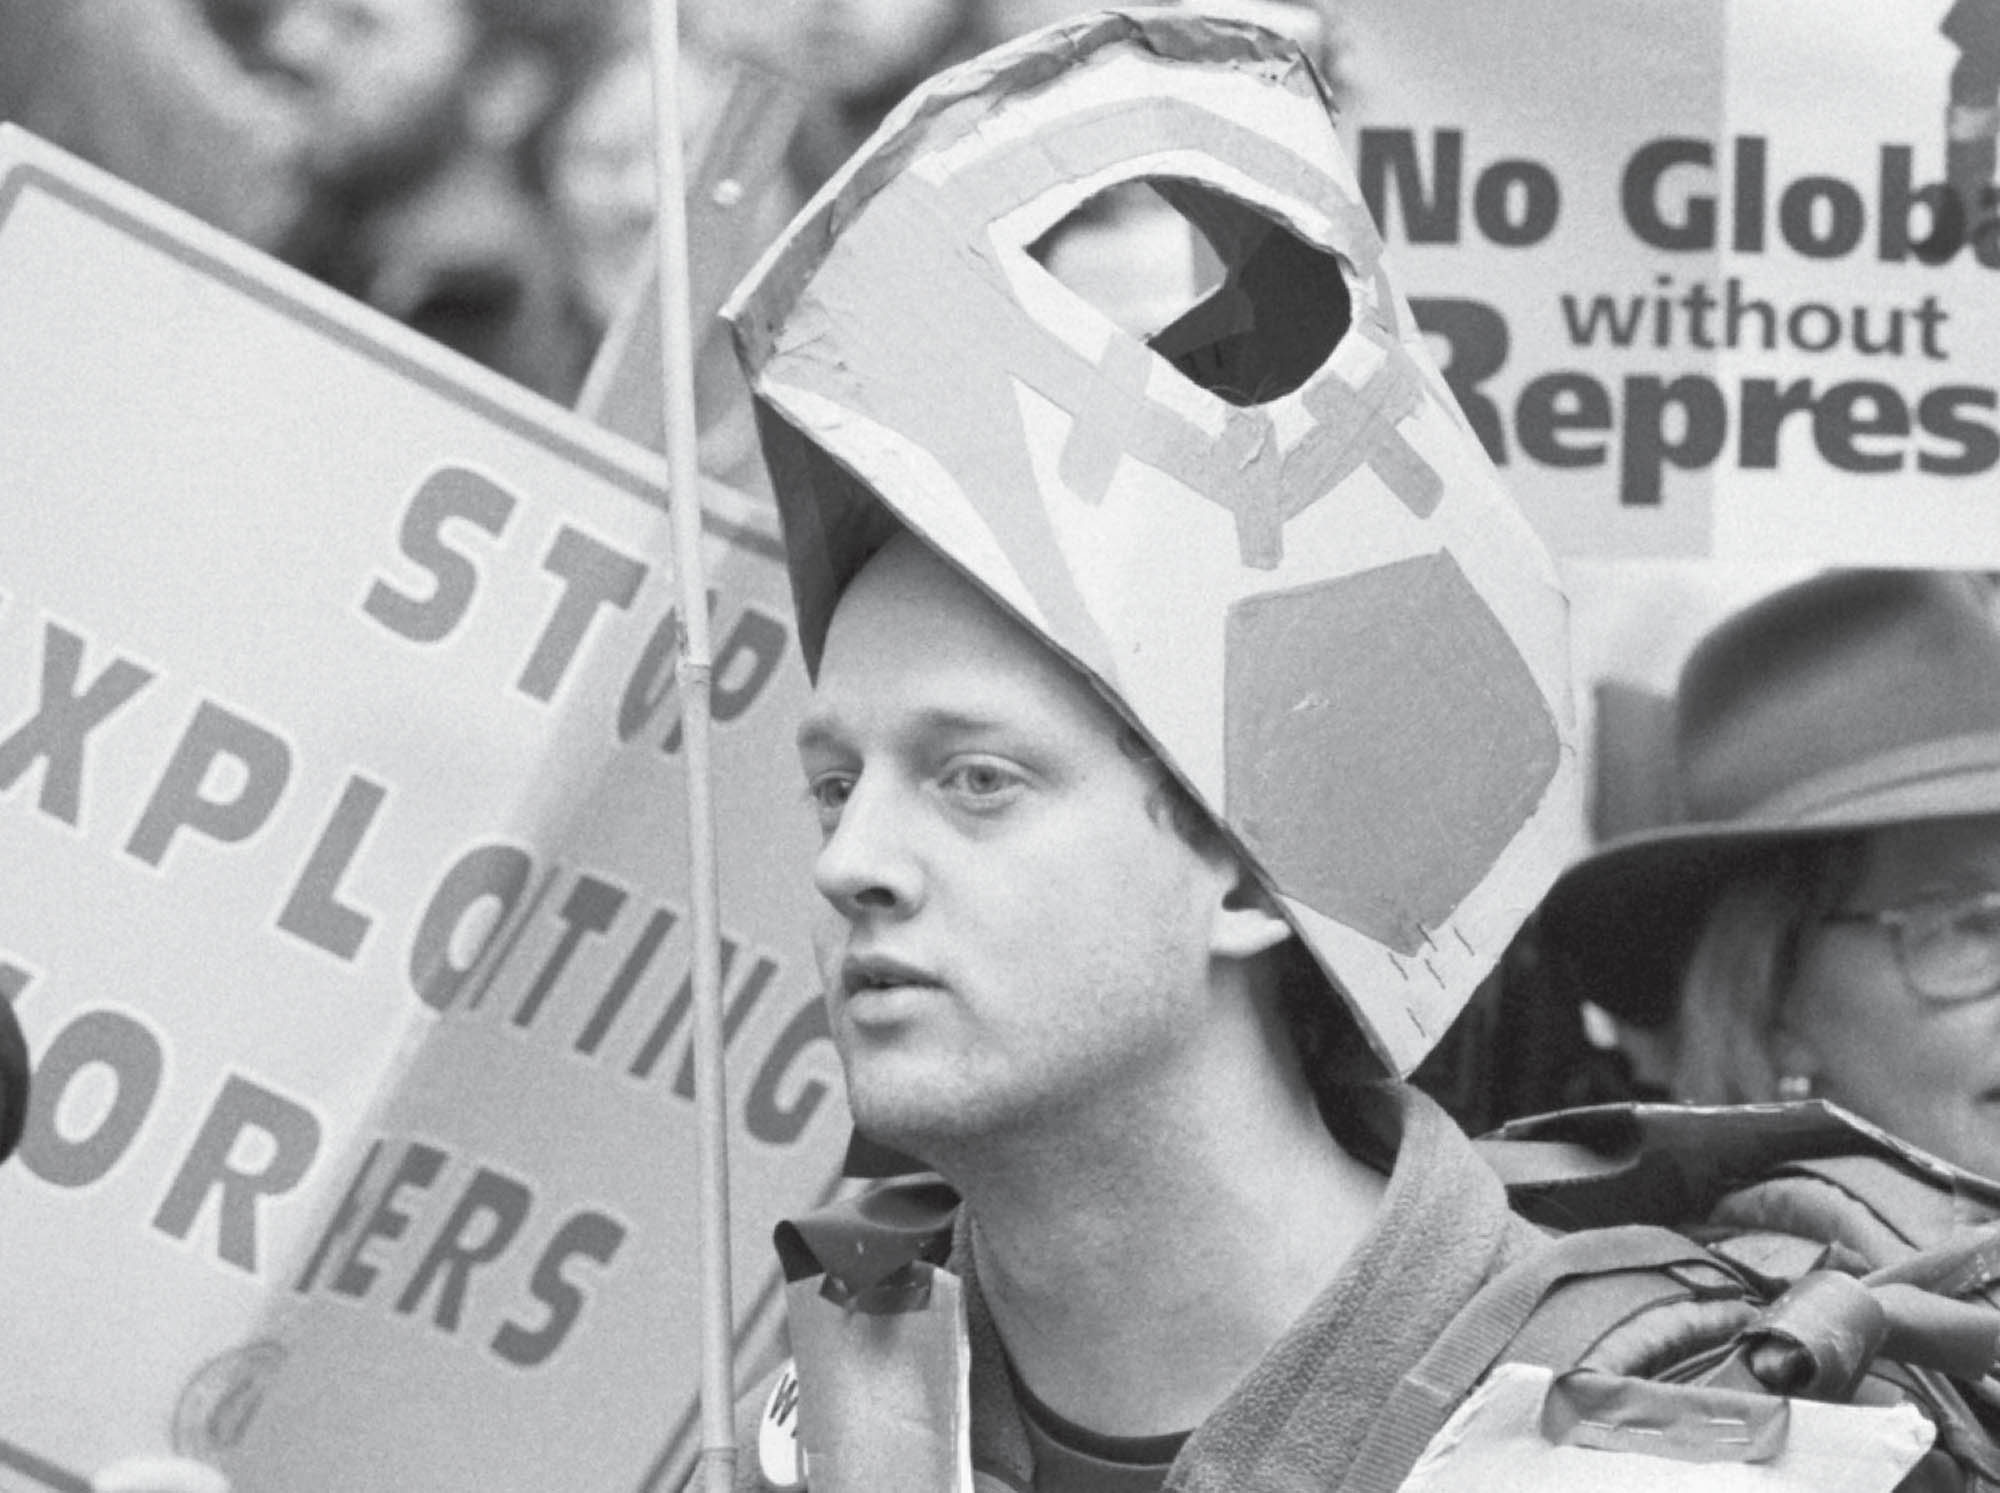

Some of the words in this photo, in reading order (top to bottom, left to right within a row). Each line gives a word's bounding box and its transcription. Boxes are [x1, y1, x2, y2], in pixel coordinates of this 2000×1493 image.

[1358, 127, 1561, 248] No
[1559, 275, 1949, 360] without
[1406, 296, 2000, 508] Repres
